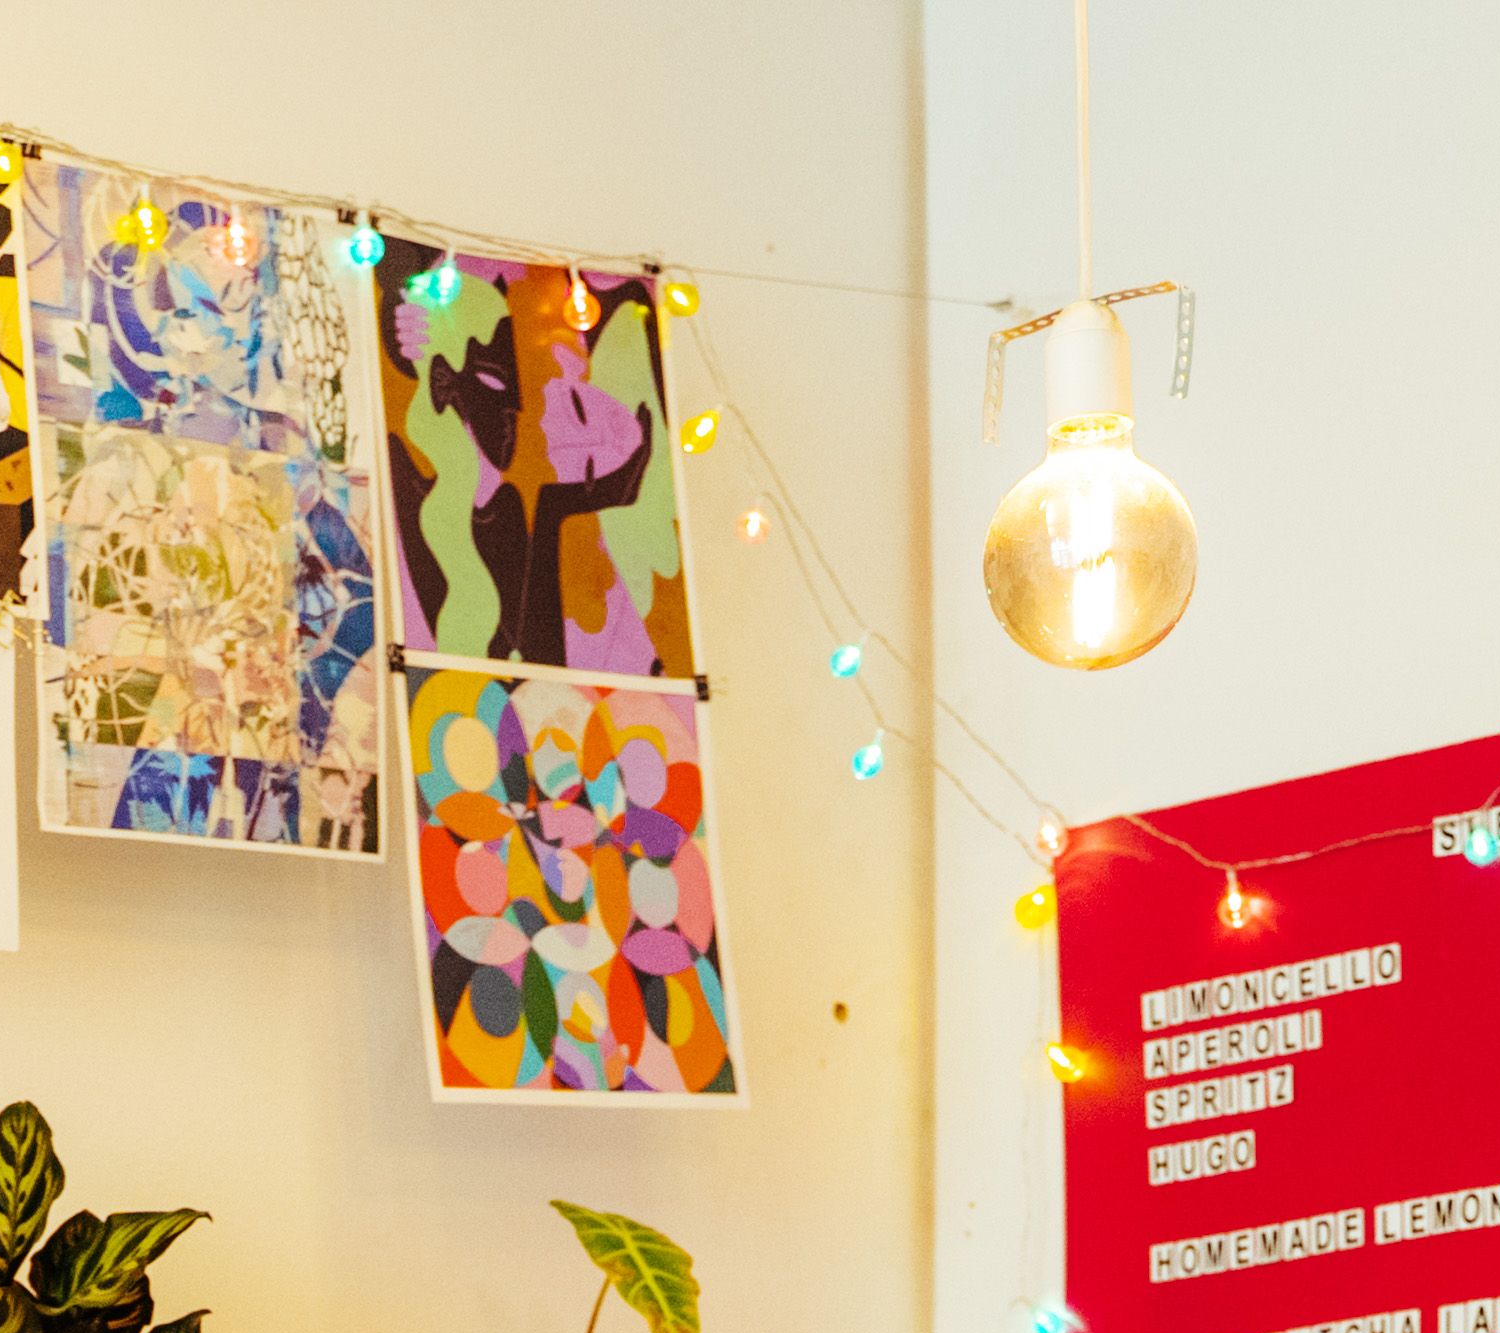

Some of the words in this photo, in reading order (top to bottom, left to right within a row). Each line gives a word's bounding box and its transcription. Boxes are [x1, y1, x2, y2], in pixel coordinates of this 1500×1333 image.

[1147, 947, 1397, 1028] LIMONCELLO
[1148, 1014, 1319, 1076] APEROLI
[1150, 1068, 1290, 1125] SPRITZ
[1153, 1133, 1254, 1181] HUGO
[1155, 1212, 1362, 1279] HOMEMADE
